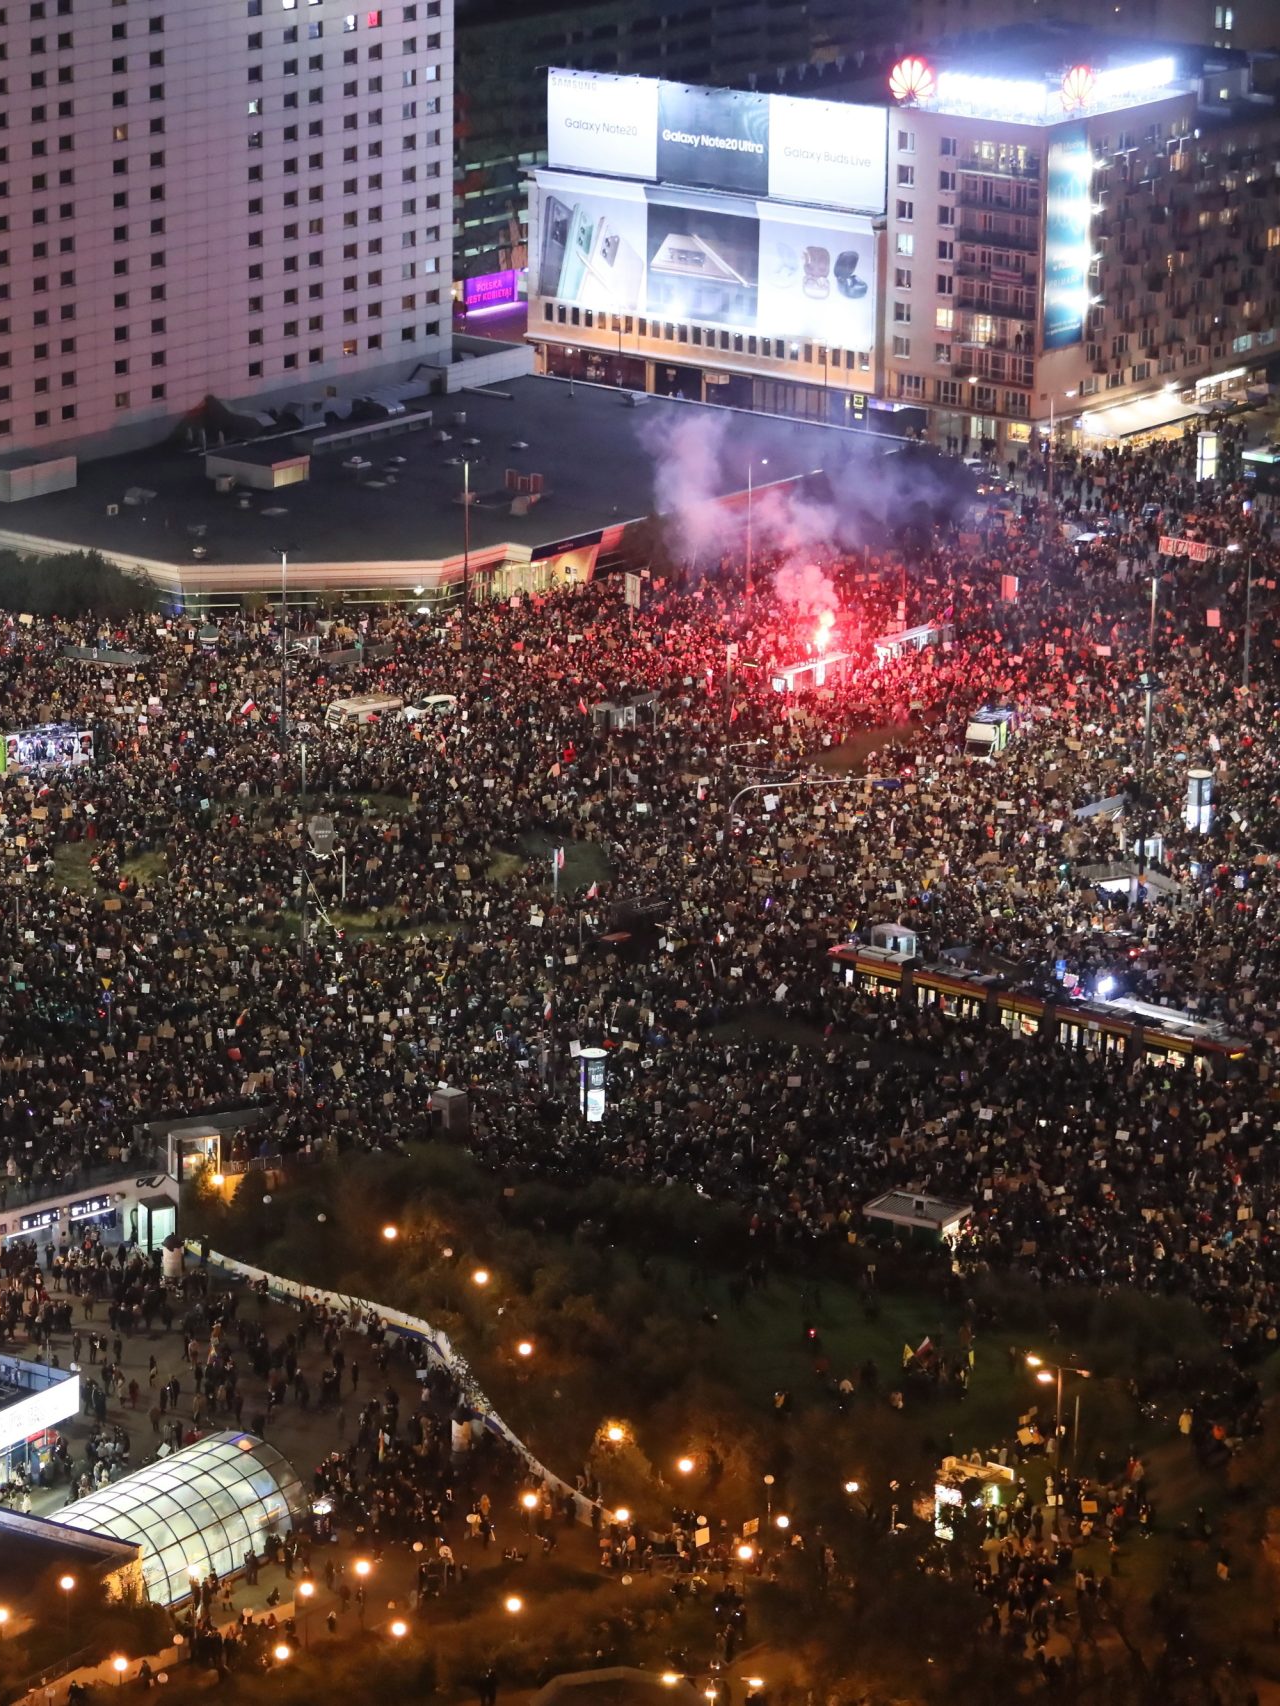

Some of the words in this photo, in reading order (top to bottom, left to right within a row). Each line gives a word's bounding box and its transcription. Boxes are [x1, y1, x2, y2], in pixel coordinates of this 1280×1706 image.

[551, 76, 597, 91] SAMSUNG
[564, 118, 601, 135] Galaxy
[602, 123, 638, 136] Note20
[662, 129, 701, 148] Galaxy
[701, 132, 738, 150] Note20
[738, 139, 764, 154] Ultra
[783, 146, 822, 163] Galaxy
[823, 151, 849, 165] Buds
[850, 155, 872, 168] Live
